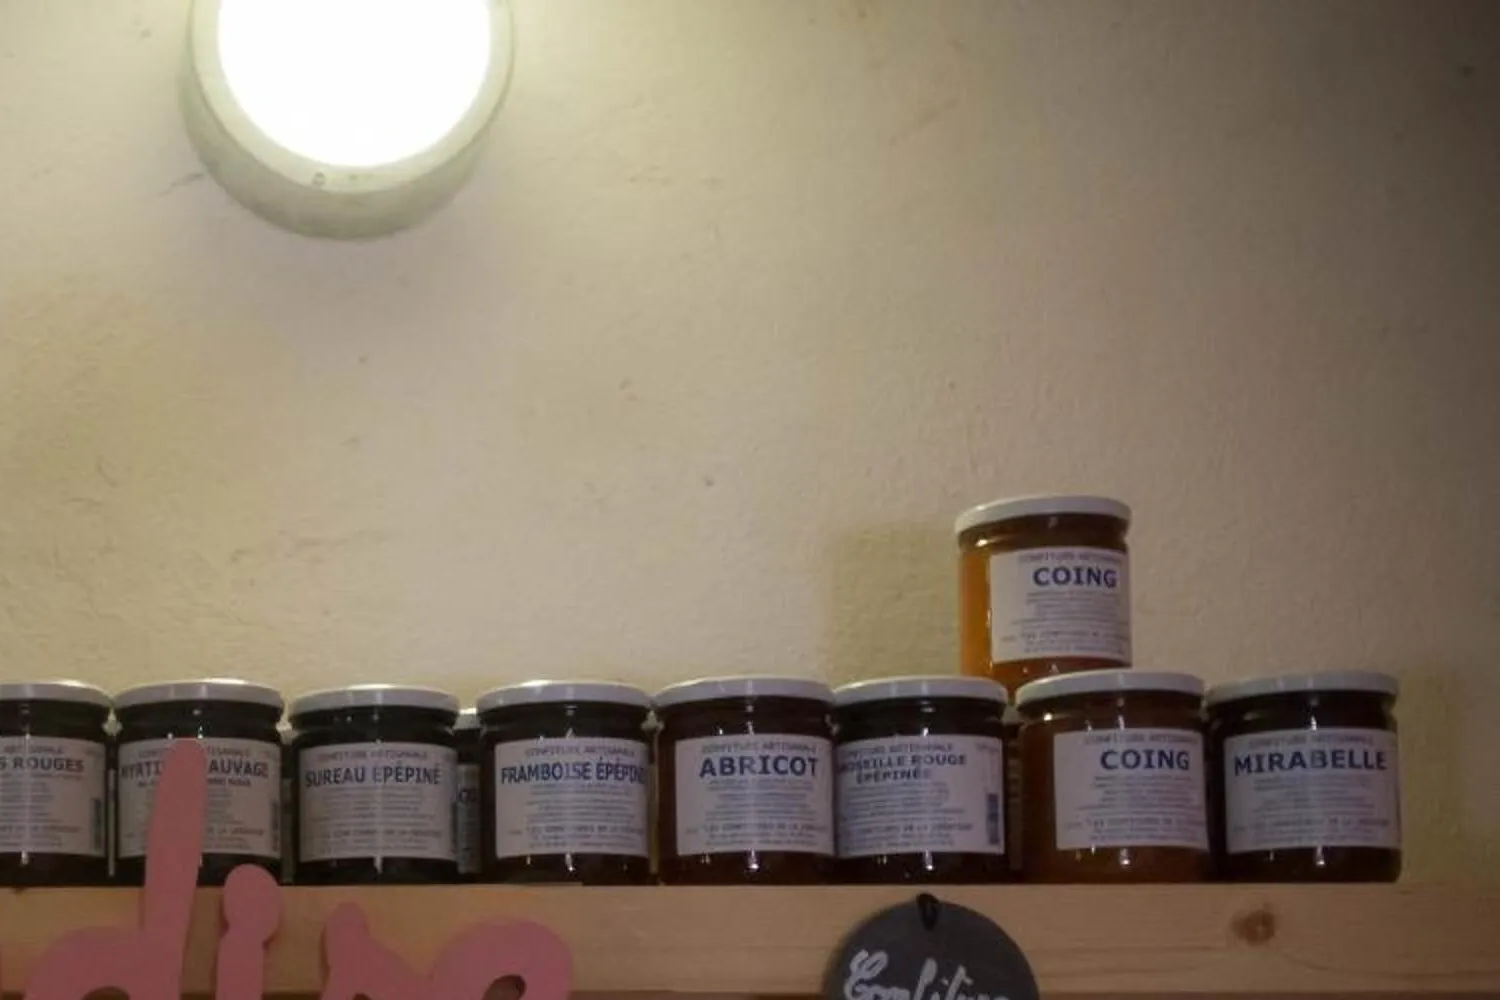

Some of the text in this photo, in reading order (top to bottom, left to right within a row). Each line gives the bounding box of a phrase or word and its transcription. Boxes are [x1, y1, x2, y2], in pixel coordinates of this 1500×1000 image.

[1032, 565, 1118, 589] COING
[13, 755, 84, 772] ROUGES
[209, 758, 269, 779] AUVAGE
[699, 755, 819, 778] ABRICOT
[911, 754, 967, 767] ROUGE
[1100, 748, 1190, 771] COING
[1232, 748, 1389, 777] MIRABELLE
[305, 763, 366, 787] SUREAU
[500, 761, 593, 784] FRAMBOISE
